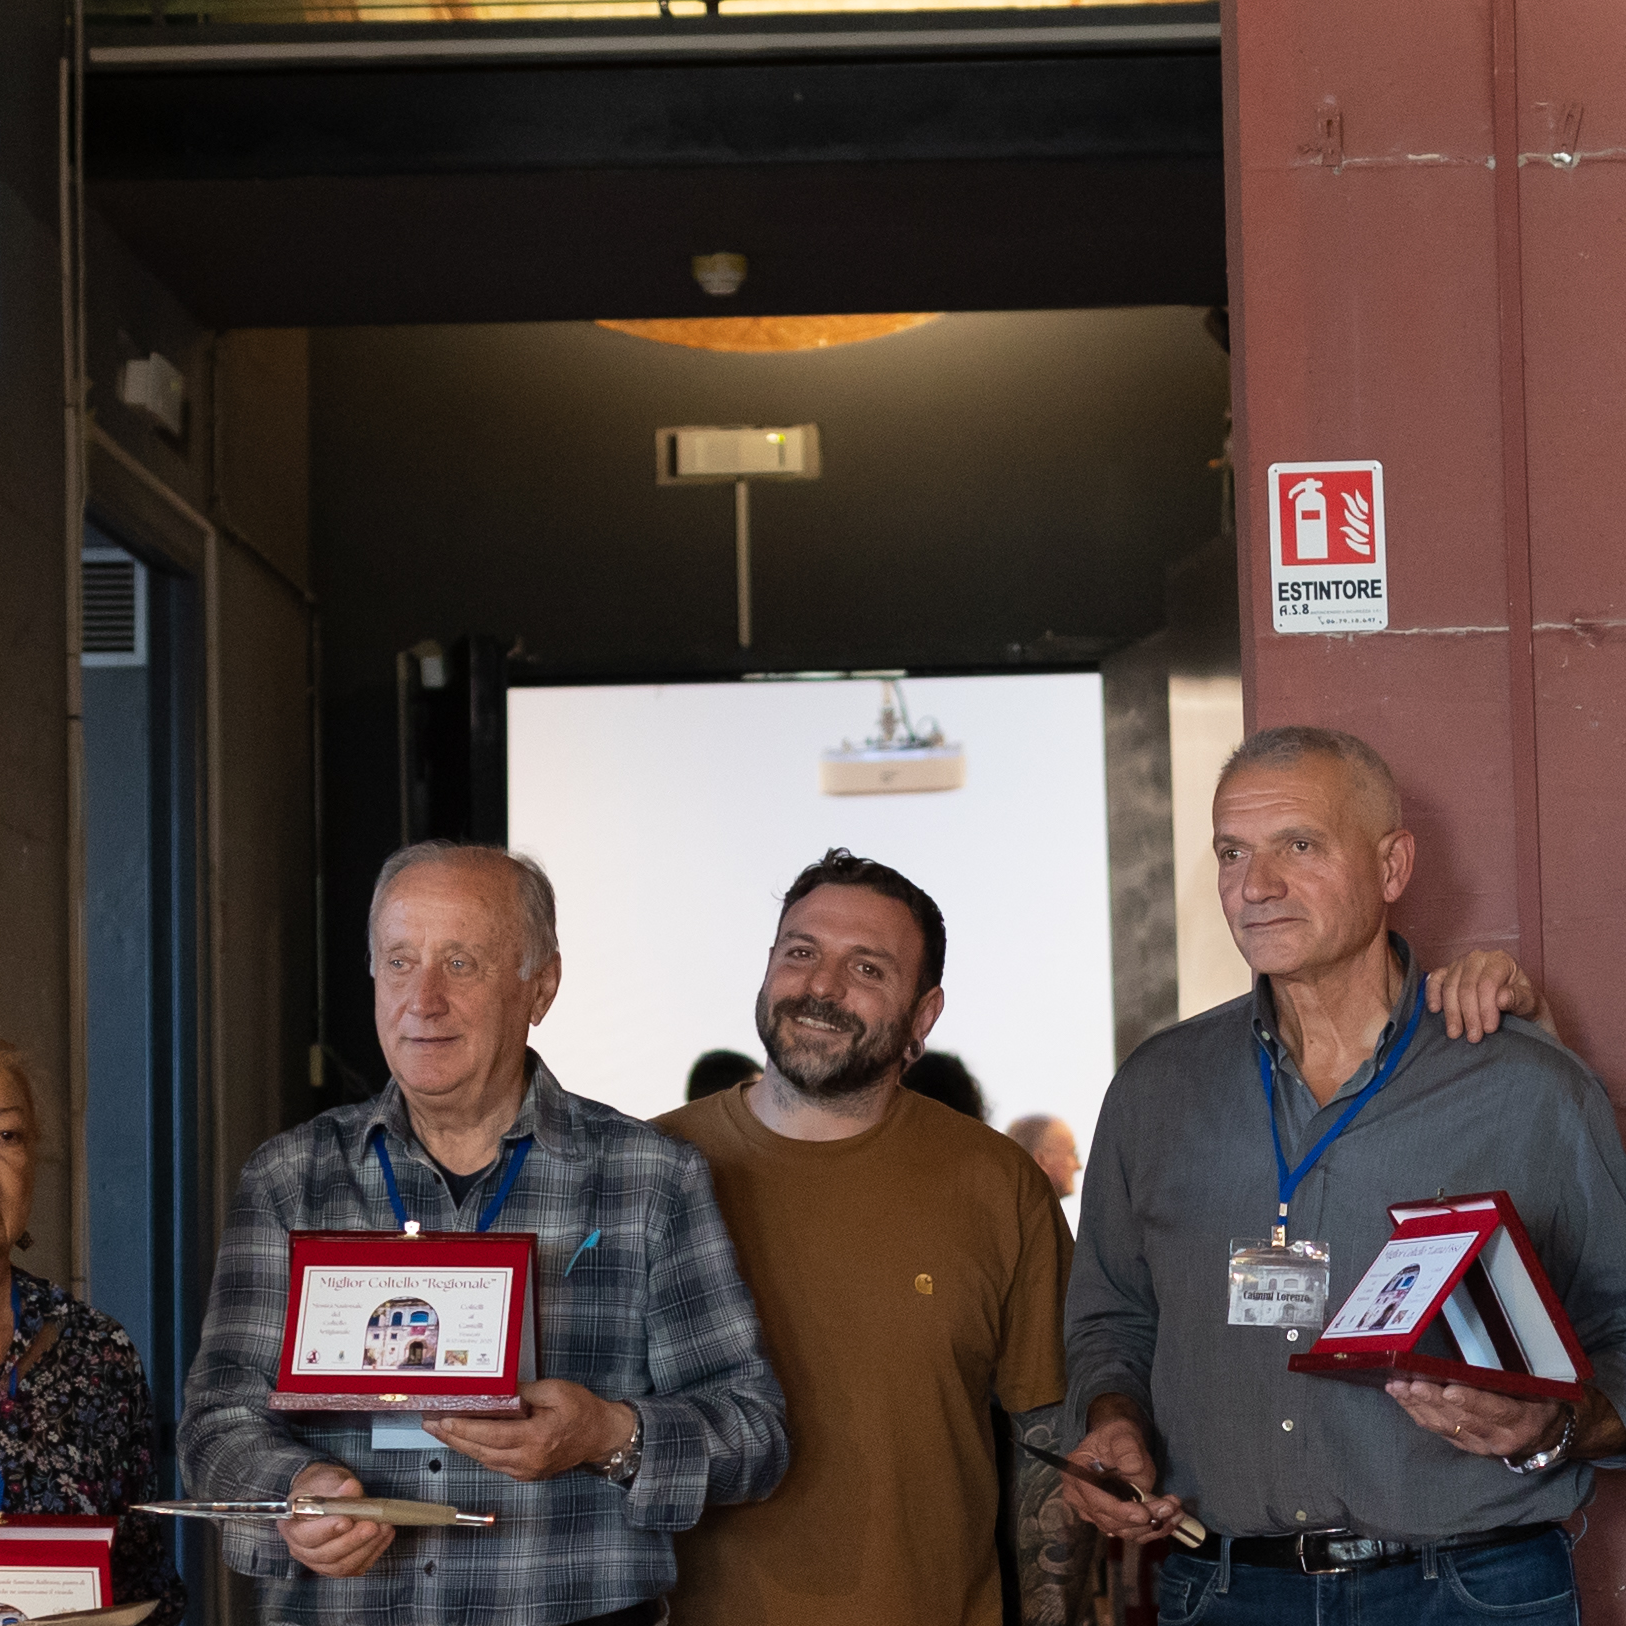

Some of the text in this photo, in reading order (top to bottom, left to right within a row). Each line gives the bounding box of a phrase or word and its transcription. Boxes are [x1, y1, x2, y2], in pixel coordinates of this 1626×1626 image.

[1278, 579, 1383, 602] ESTINTORE
[320, 1276, 497, 1292] Miglior Coltello "Regionale"
